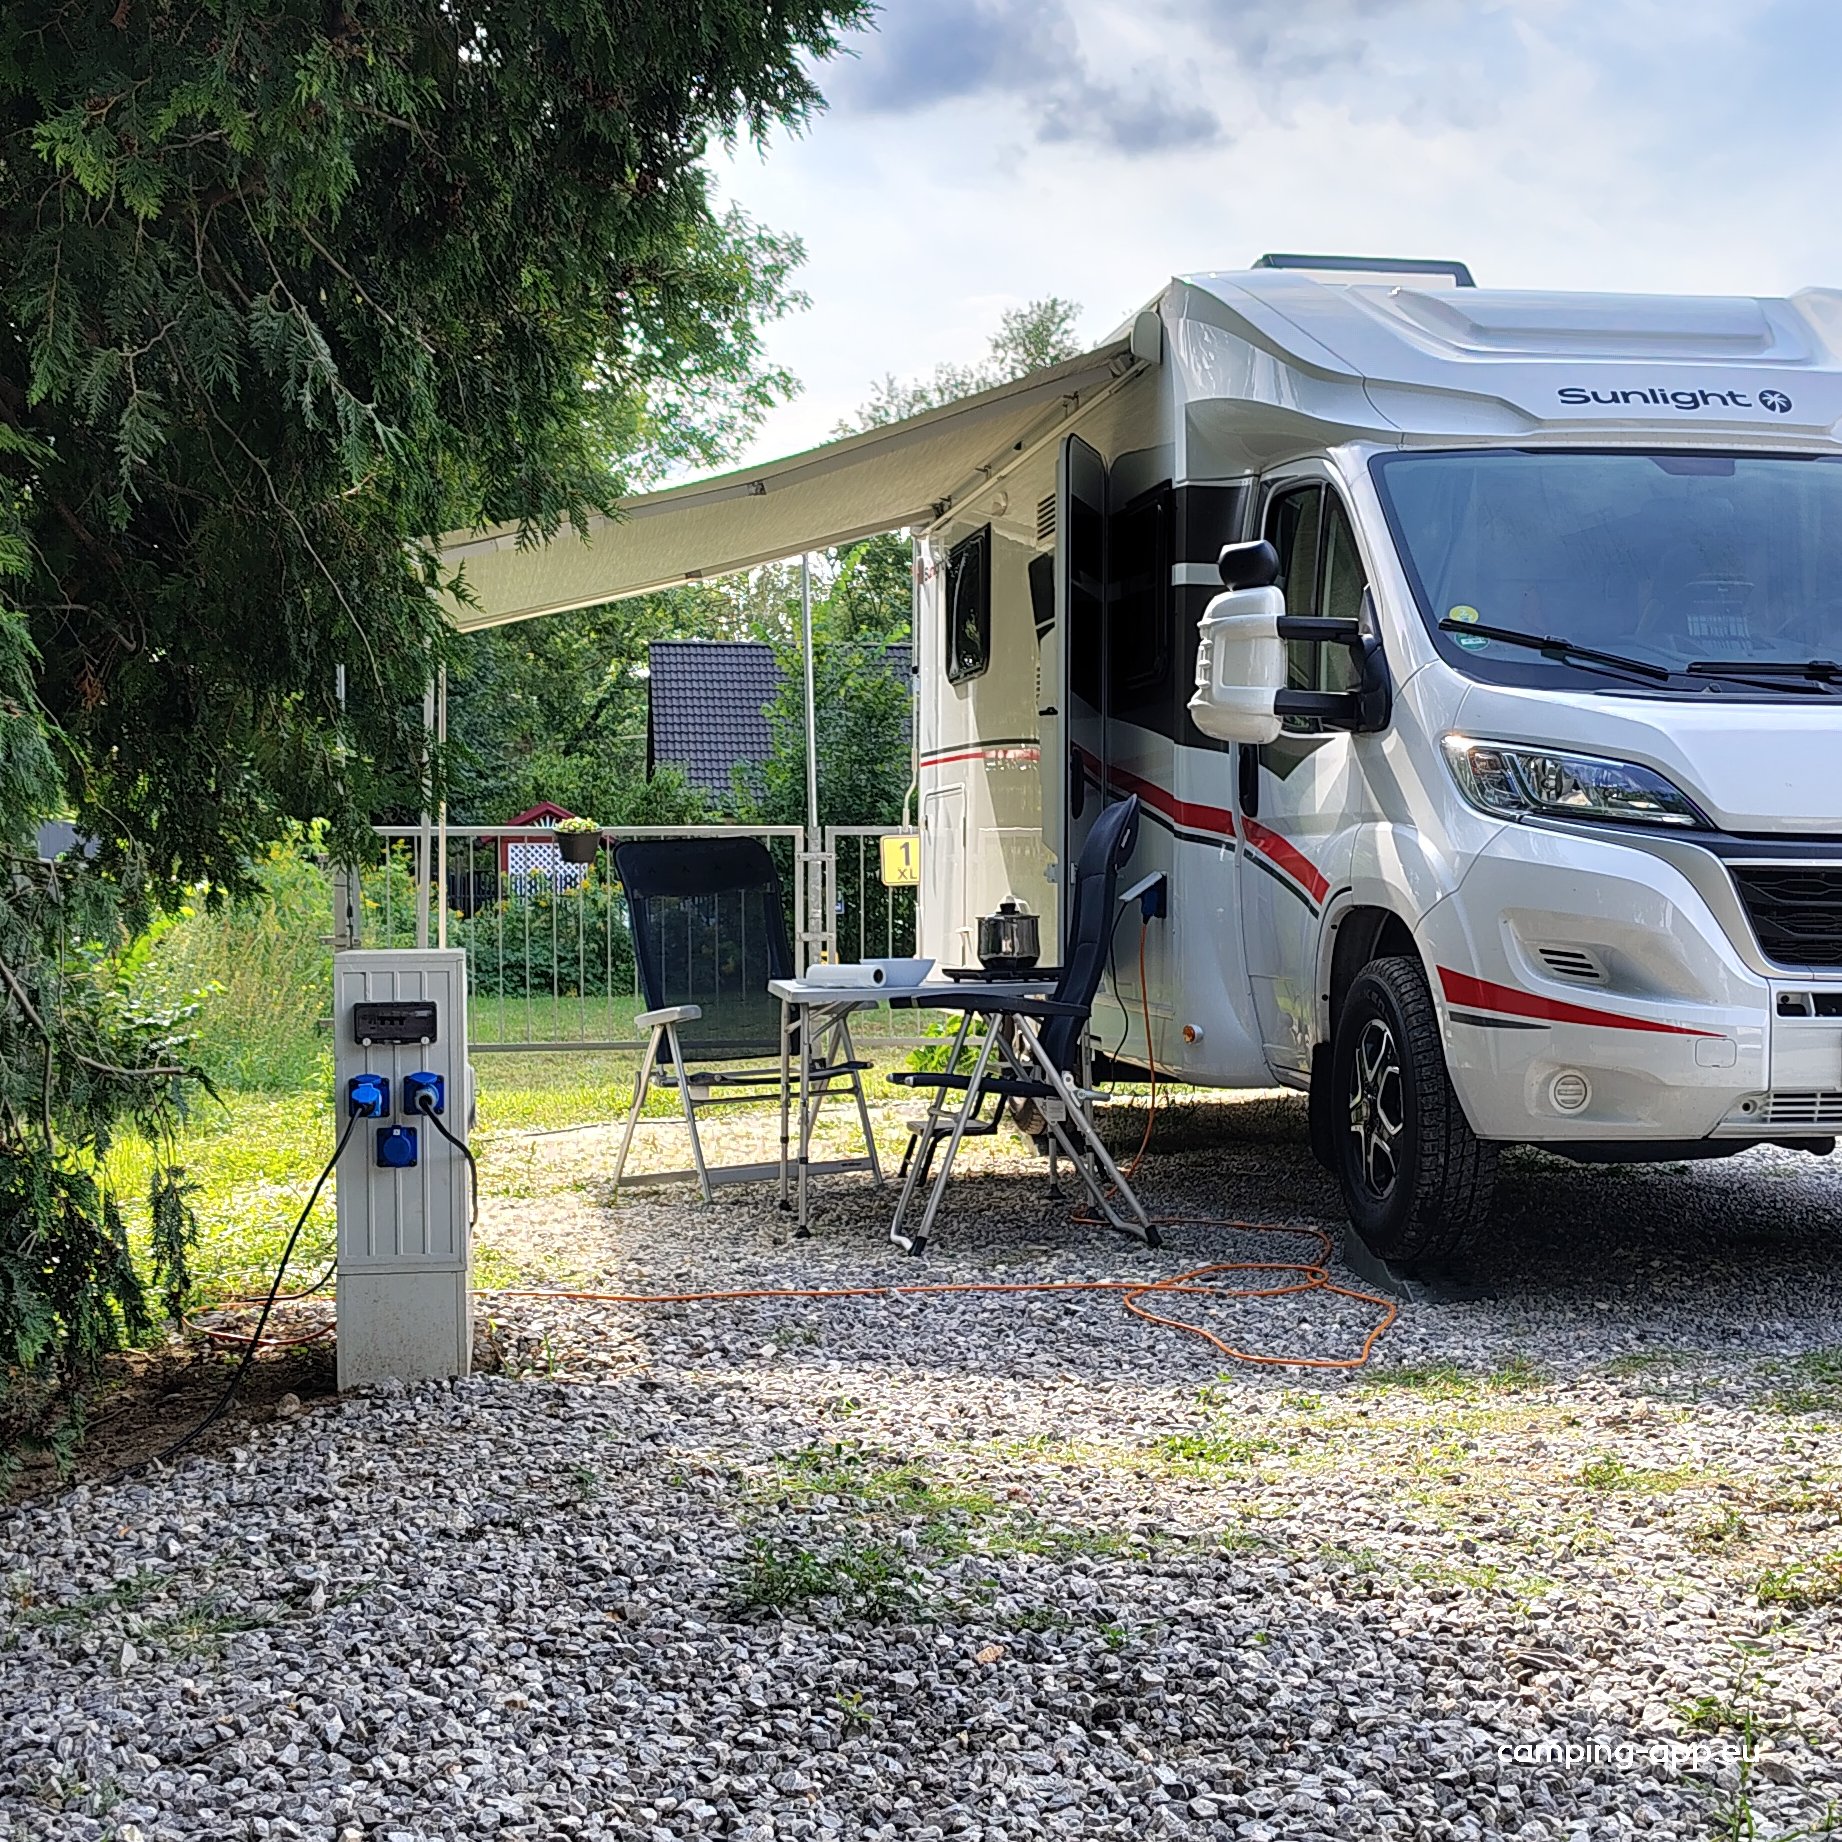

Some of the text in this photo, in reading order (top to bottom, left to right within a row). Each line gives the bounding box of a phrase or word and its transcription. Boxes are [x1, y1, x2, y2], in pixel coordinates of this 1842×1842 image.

[1558, 388, 1752, 411] Sunlight
[899, 841, 911, 866] 1
[897, 868, 918, 880] XL
